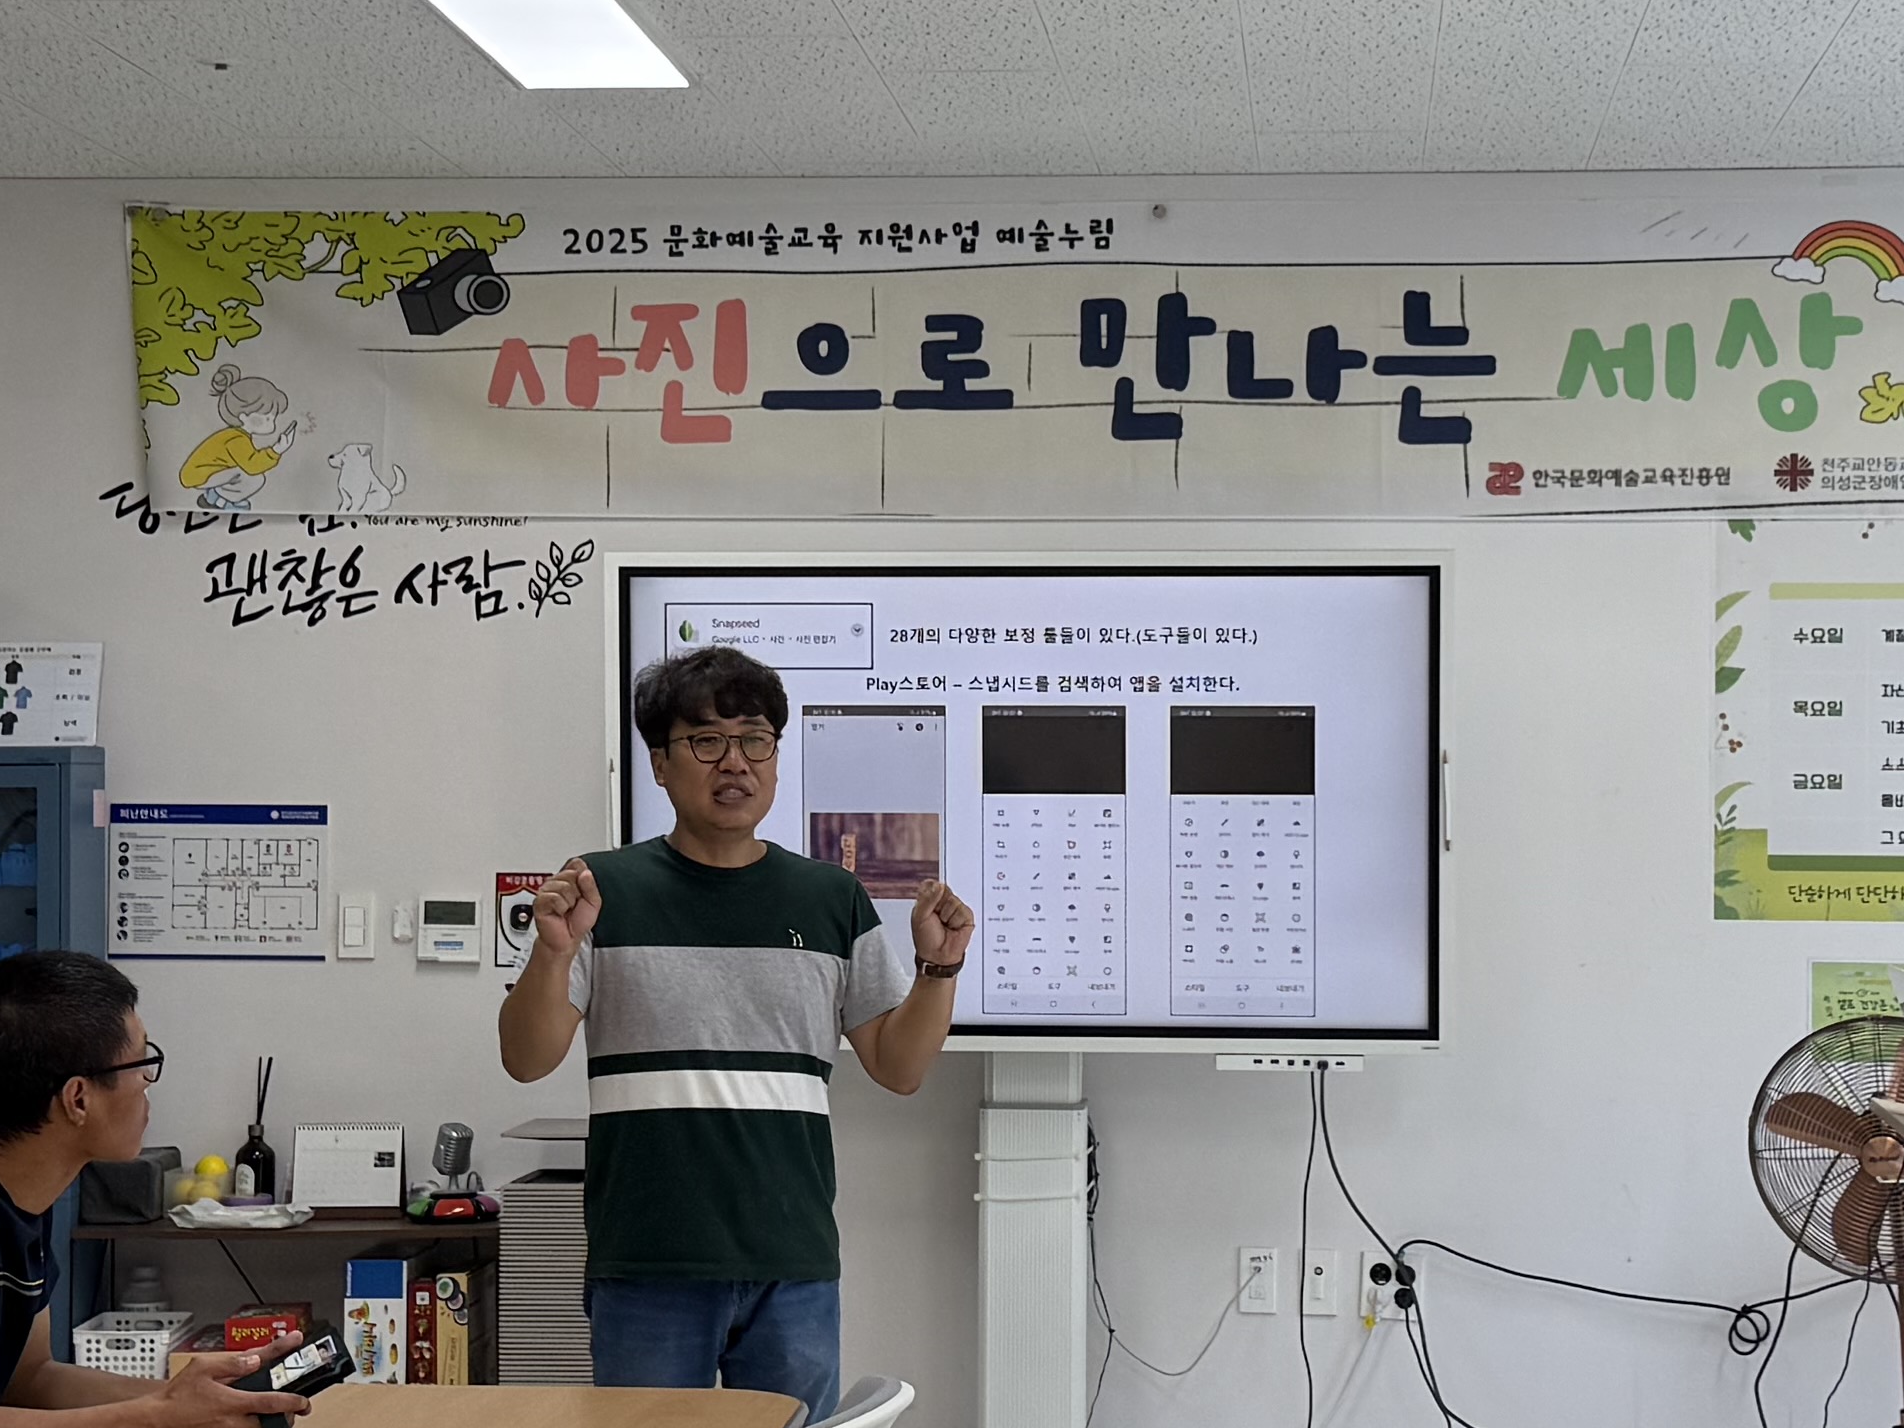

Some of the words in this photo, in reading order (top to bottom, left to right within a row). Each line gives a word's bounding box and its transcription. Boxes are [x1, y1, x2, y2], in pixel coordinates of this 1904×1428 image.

[562, 227, 649, 256] 2025
[662, 221, 843, 257] 문화예술교육
[857, 220, 981, 255] 지원사업
[995, 217, 1115, 252] 예술누림
[487, 297, 1015, 445] 사진으로
[1078, 289, 1497, 446] 만나는
[1555, 290, 1864, 433] 세상
[1531, 466, 1732, 489] 한국문화예술교육진흥원
[426, 516, 453, 533] my
[203, 544, 379, 628] 괜찮은
[711, 617, 761, 630] Snapseed
[711, 634, 741, 646] Google
[889, 627, 942, 644] 28개의
[947, 627, 997, 644] 다양한
[1003, 627, 1036, 644] 보정
[1215, 626, 1259, 645] 있다.)
[1792, 627, 1844, 644] 수요일
[865, 674, 949, 693] Play스토어
[968, 674, 1050, 693] 스냅시드를
[1057, 675, 1123, 693] 검색하여
[1129, 675, 1162, 693] 앱을
[1168, 675, 1241, 693] 설치한다.
[1792, 699, 1844, 717] 목요일
[1792, 773, 1844, 790] 금요일
[1880, 830, 1896, 845] 그
[1787, 883, 1852, 903] 단순하게
